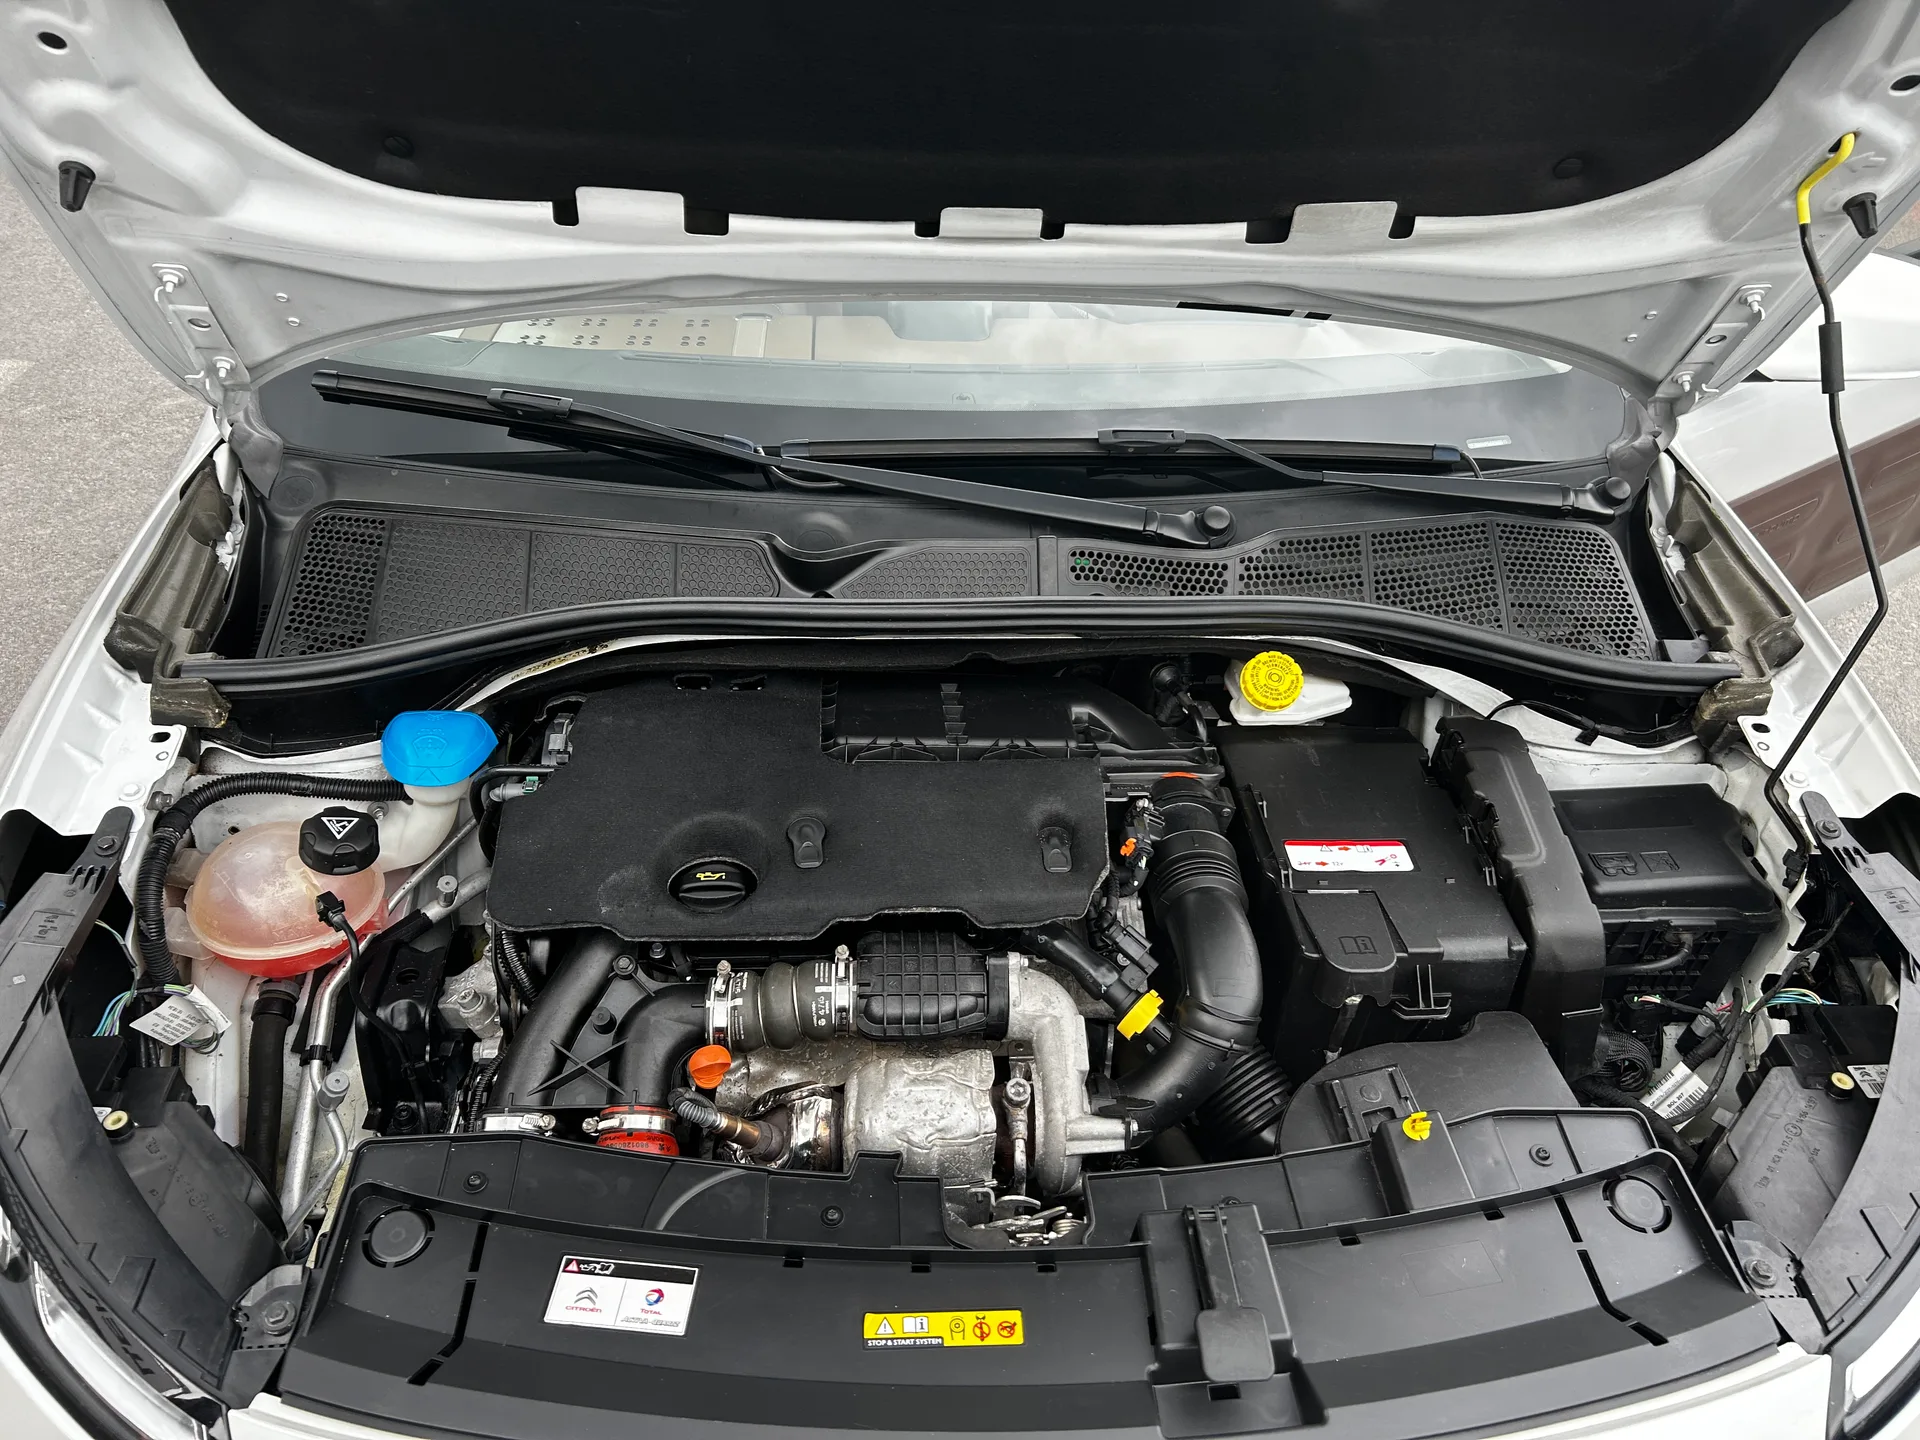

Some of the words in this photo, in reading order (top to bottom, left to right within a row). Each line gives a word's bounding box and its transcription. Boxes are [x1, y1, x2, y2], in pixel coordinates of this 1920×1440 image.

[565, 1305, 602, 1313] CITROËN
[893, 1338, 915, 1346] START
[916, 1337, 942, 1345] SYSTEM
